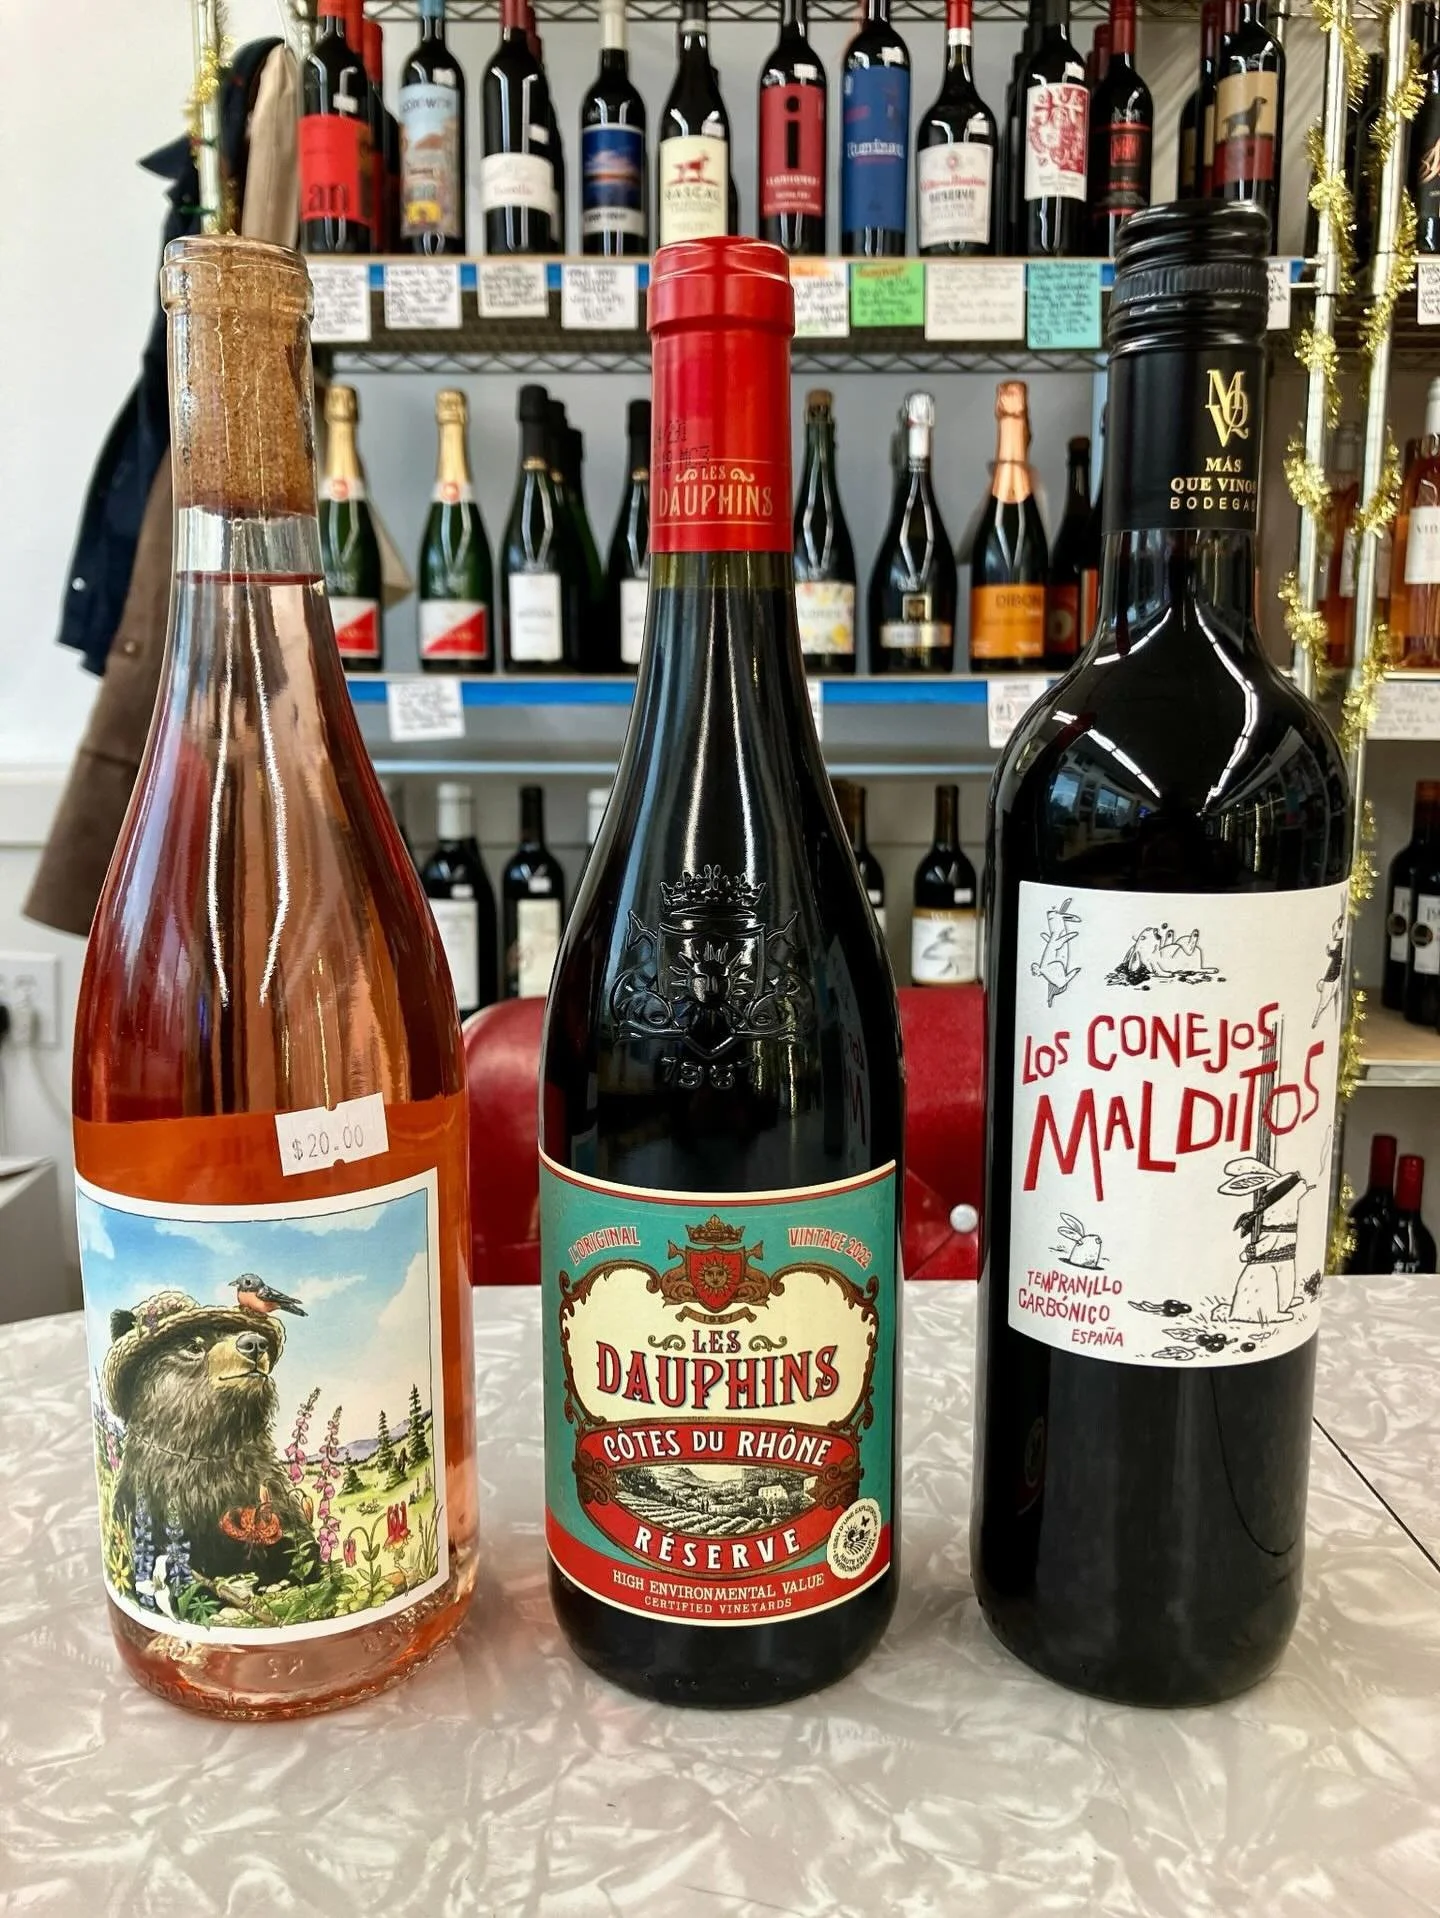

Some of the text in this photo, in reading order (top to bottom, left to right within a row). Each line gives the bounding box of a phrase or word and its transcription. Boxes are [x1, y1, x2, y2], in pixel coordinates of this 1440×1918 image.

[702, 465, 727, 481] LES
[1204, 456, 1242, 473] MÁS
[659, 484, 774, 517] DAUPHINS
[1170, 477, 1212, 494] QUE
[1022, 1002, 1279, 1085] LOS CONEJOS
[1023, 1040, 1325, 1202] MALDITOS
[291, 1123, 365, 1160] $20.00
[788, 1227, 848, 1255] VINTAGE
[1027, 1270, 1123, 1299] TEMPRANILLO
[1018, 1287, 1111, 1324] CARBÓNICO
[691, 1329, 742, 1354] LES
[1071, 1327, 1124, 1346] ESPAÑA
[596, 1340, 840, 1410] DAUPHINS
[603, 1425, 832, 1467] CÔTES DU RHÔNE
[633, 1525, 801, 1570] RÉSERVE
[612, 1569, 825, 1602] HIGH ENVIRONMENTAL VALUE
[644, 1596, 793, 1615] CERTIFIED VINEYARDS
